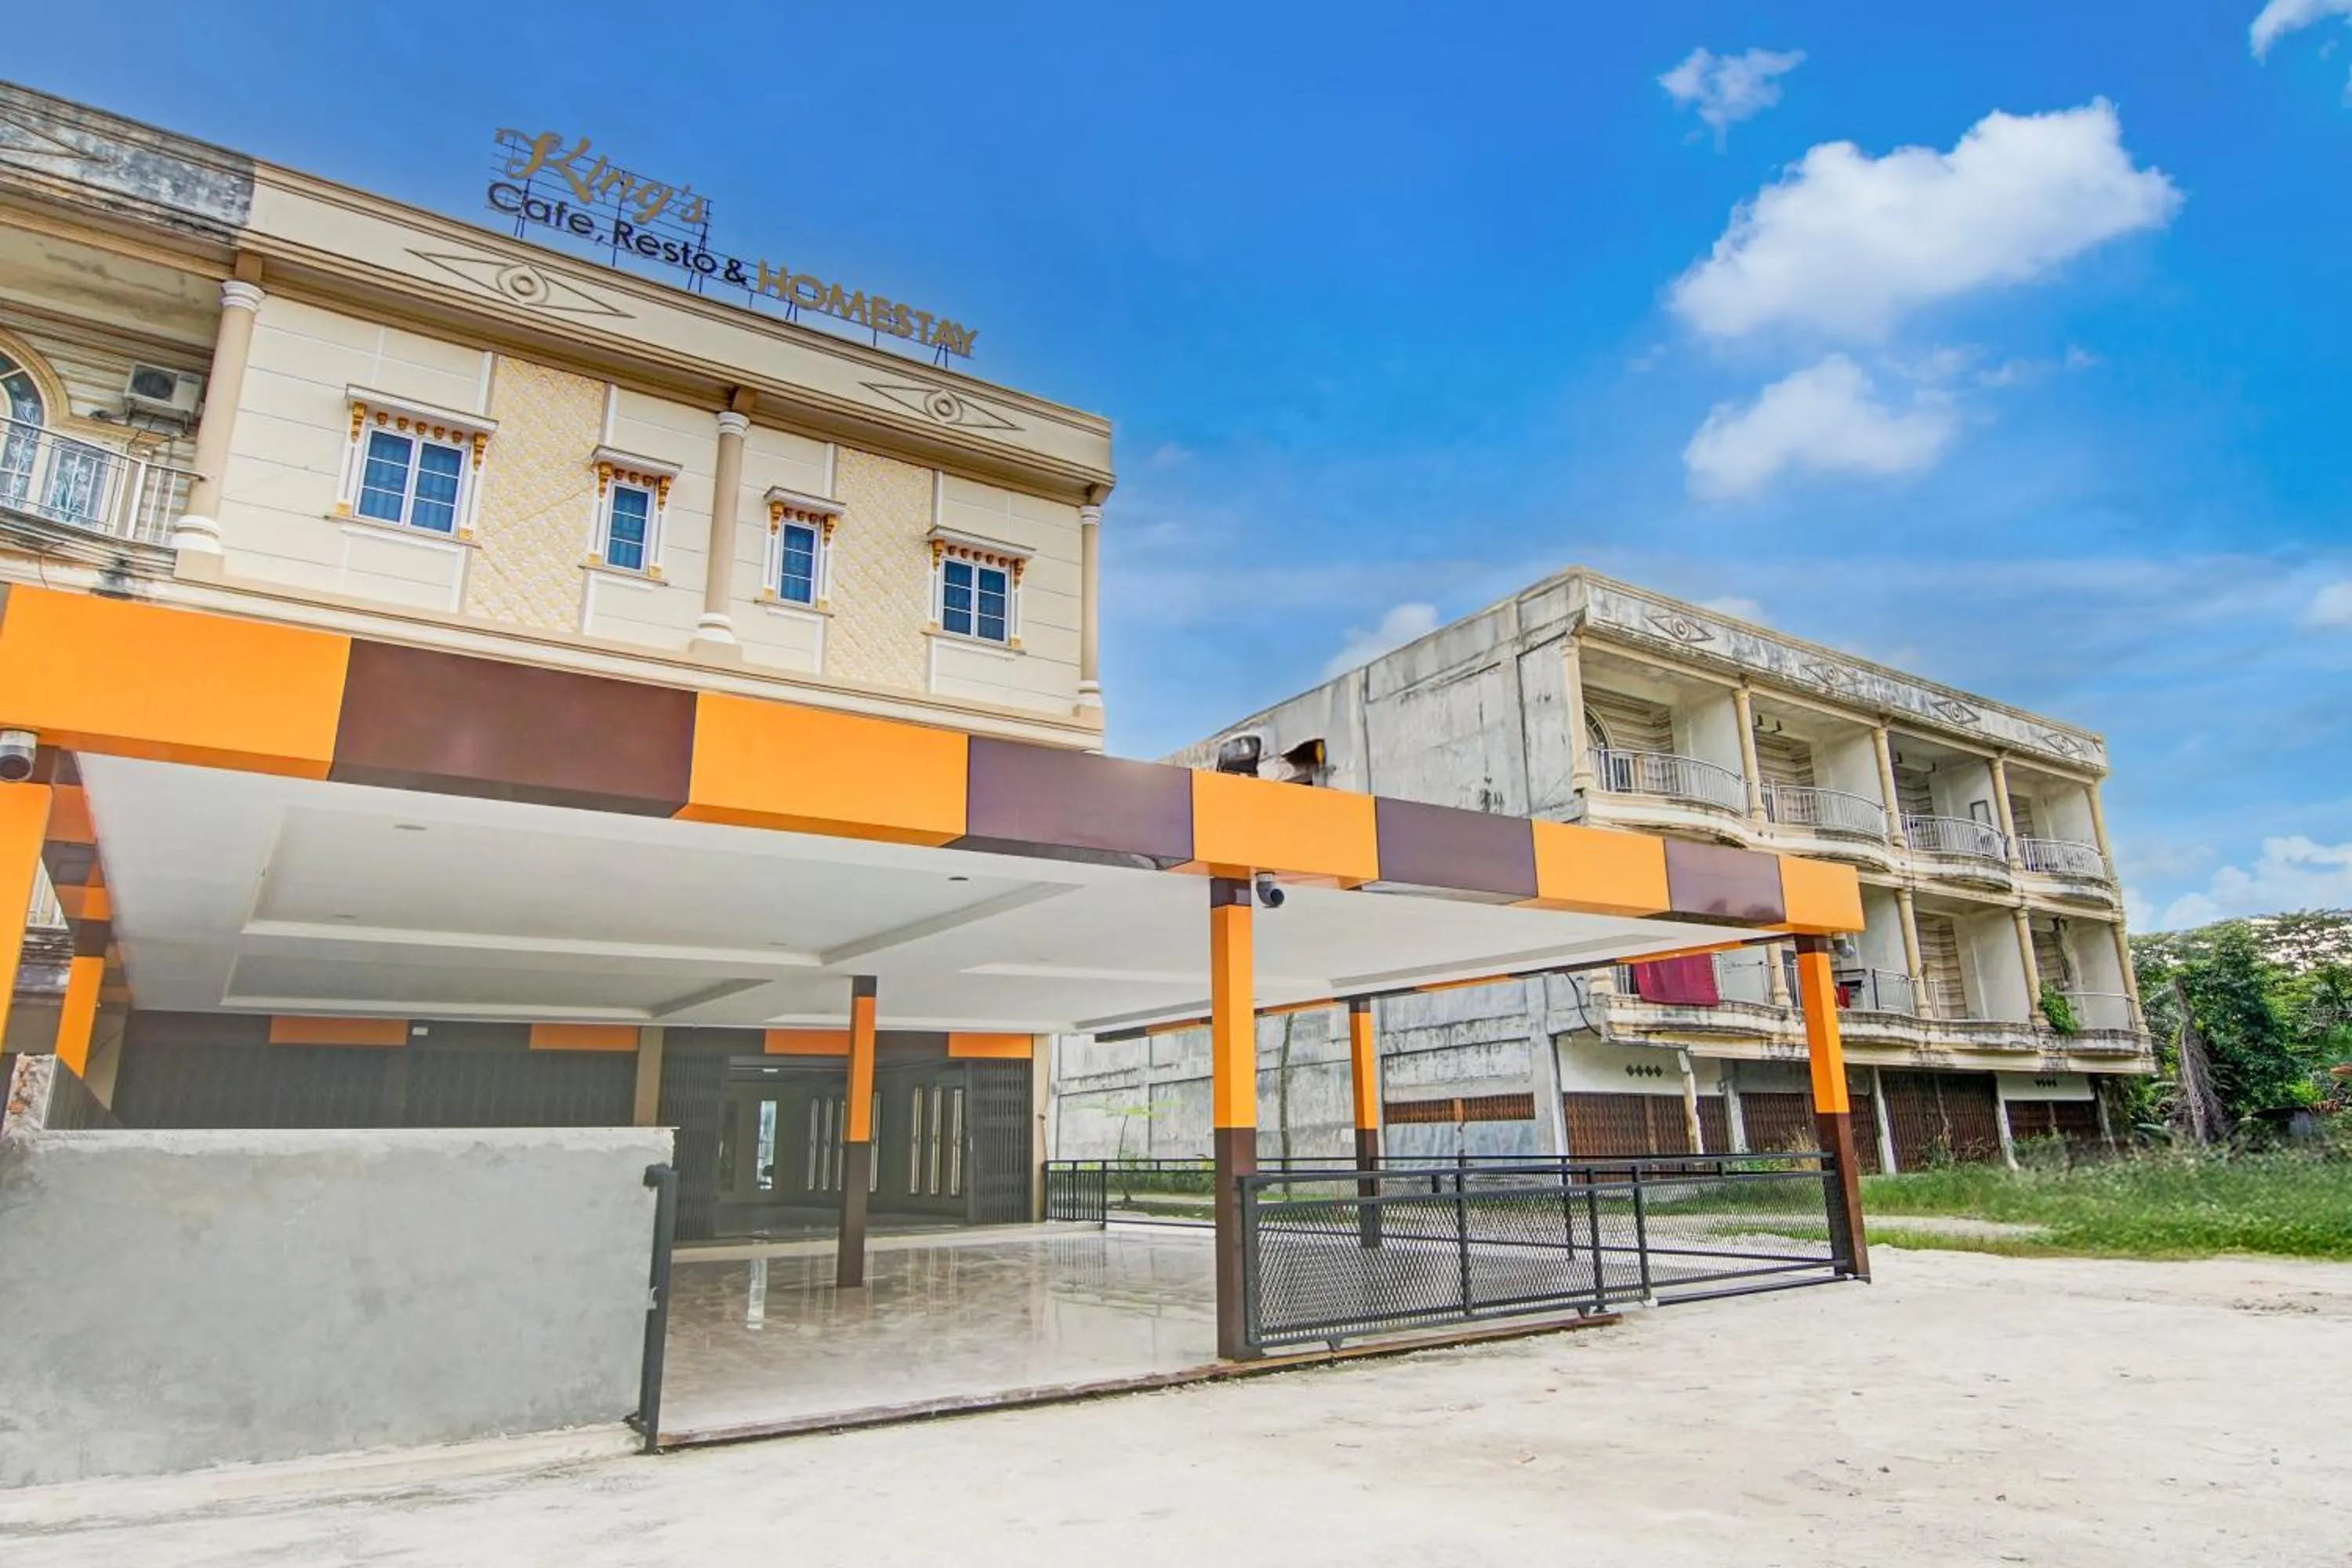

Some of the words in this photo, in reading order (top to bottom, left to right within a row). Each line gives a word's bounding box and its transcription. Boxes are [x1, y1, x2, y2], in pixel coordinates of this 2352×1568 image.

[494, 128, 706, 223] King's
[612, 219, 717, 275] Resto
[724, 258, 748, 286] &
[757, 260, 978, 357] HOMESTAY
